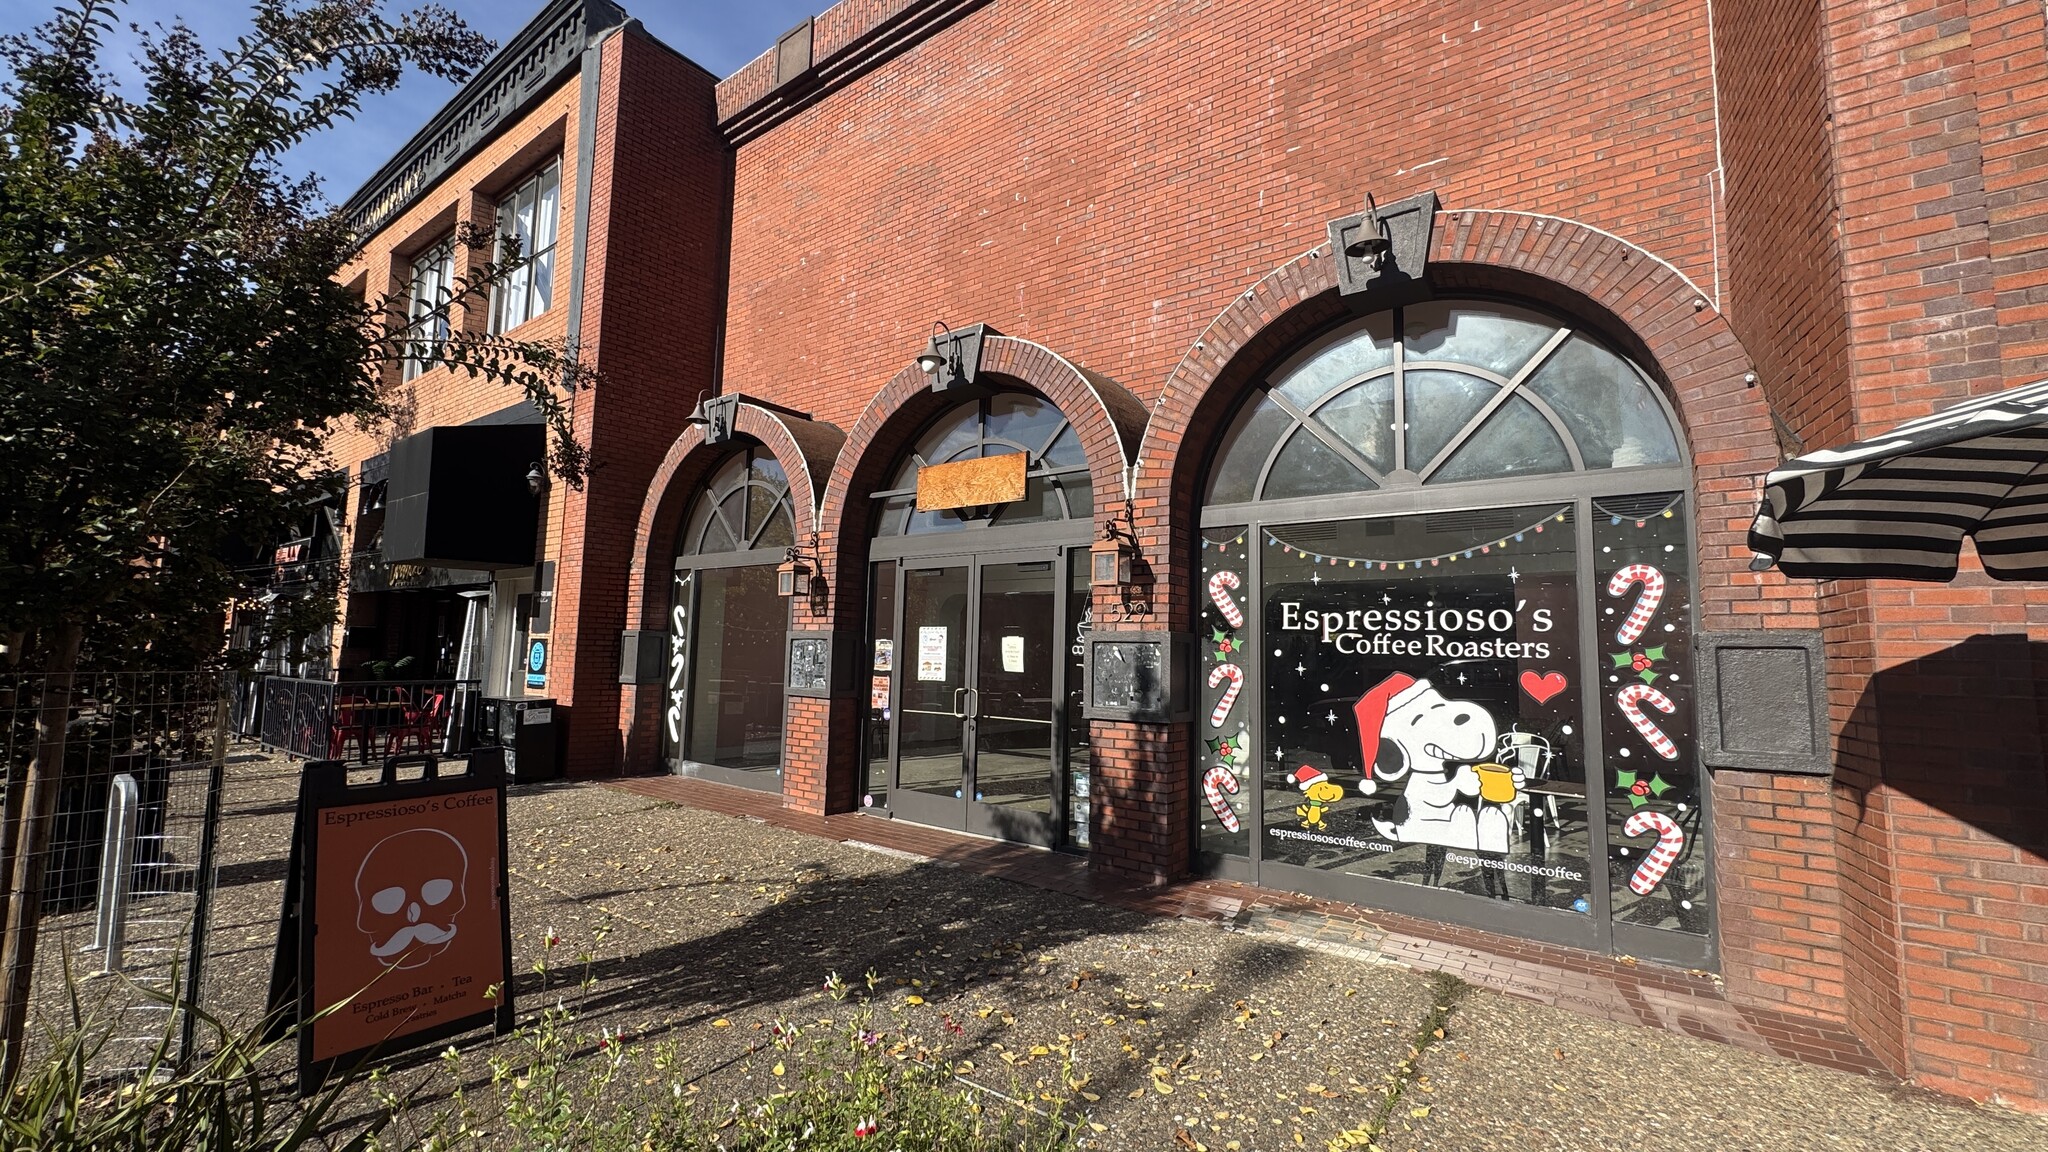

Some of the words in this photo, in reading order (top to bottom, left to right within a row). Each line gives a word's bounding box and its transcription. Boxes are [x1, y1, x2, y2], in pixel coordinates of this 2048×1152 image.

[1111, 602, 1147, 622] 529
[1281, 599, 1553, 643] Espressioso's
[1335, 632, 1422, 656] Coffee
[1426, 635, 1550, 659] Roasters
[325, 800, 439, 827] Espressioso's
[444, 794, 493, 810] Coffee
[1269, 828, 1393, 852] espressiososcoffee.com
[1445, 852, 1582, 881] @espressiososcoffee
[352, 992, 409, 1014] Espresso
[412, 985, 434, 998] Bar
[451, 974, 472, 987] Tea
[365, 1011, 389, 1024] Cold
[392, 1004, 417, 1016] Brew
[433, 990, 467, 1005] Matcha
